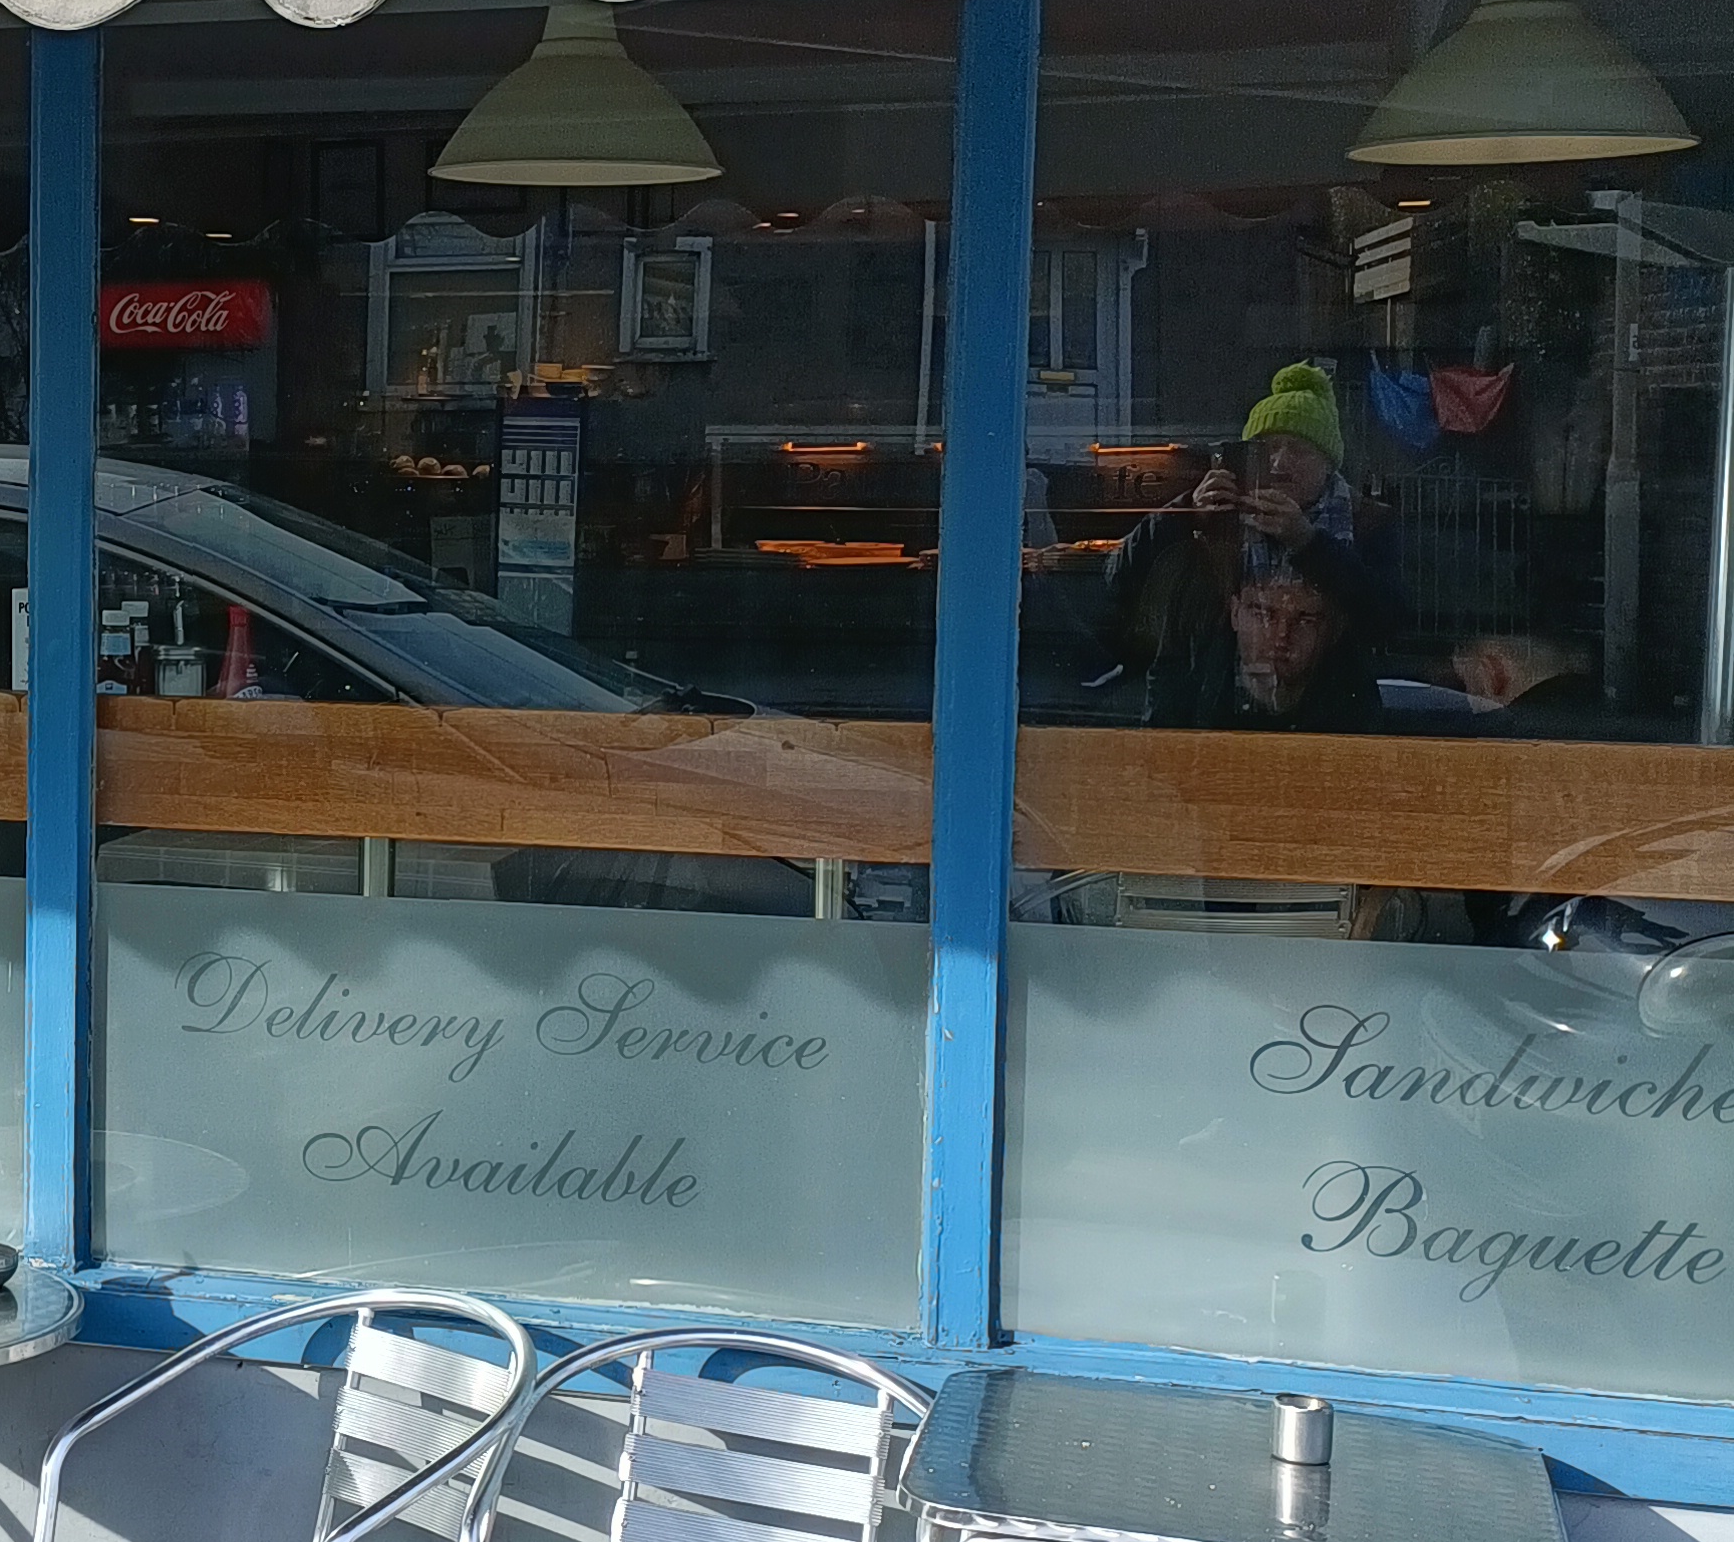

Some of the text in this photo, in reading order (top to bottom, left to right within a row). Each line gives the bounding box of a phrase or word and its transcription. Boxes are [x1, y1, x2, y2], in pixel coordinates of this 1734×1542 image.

[108, 290, 237, 335] Coca-Cola
[174, 950, 831, 1084] Delivery Service
[302, 1109, 702, 1209] Available
[1300, 1160, 1728, 1304] Baguette
